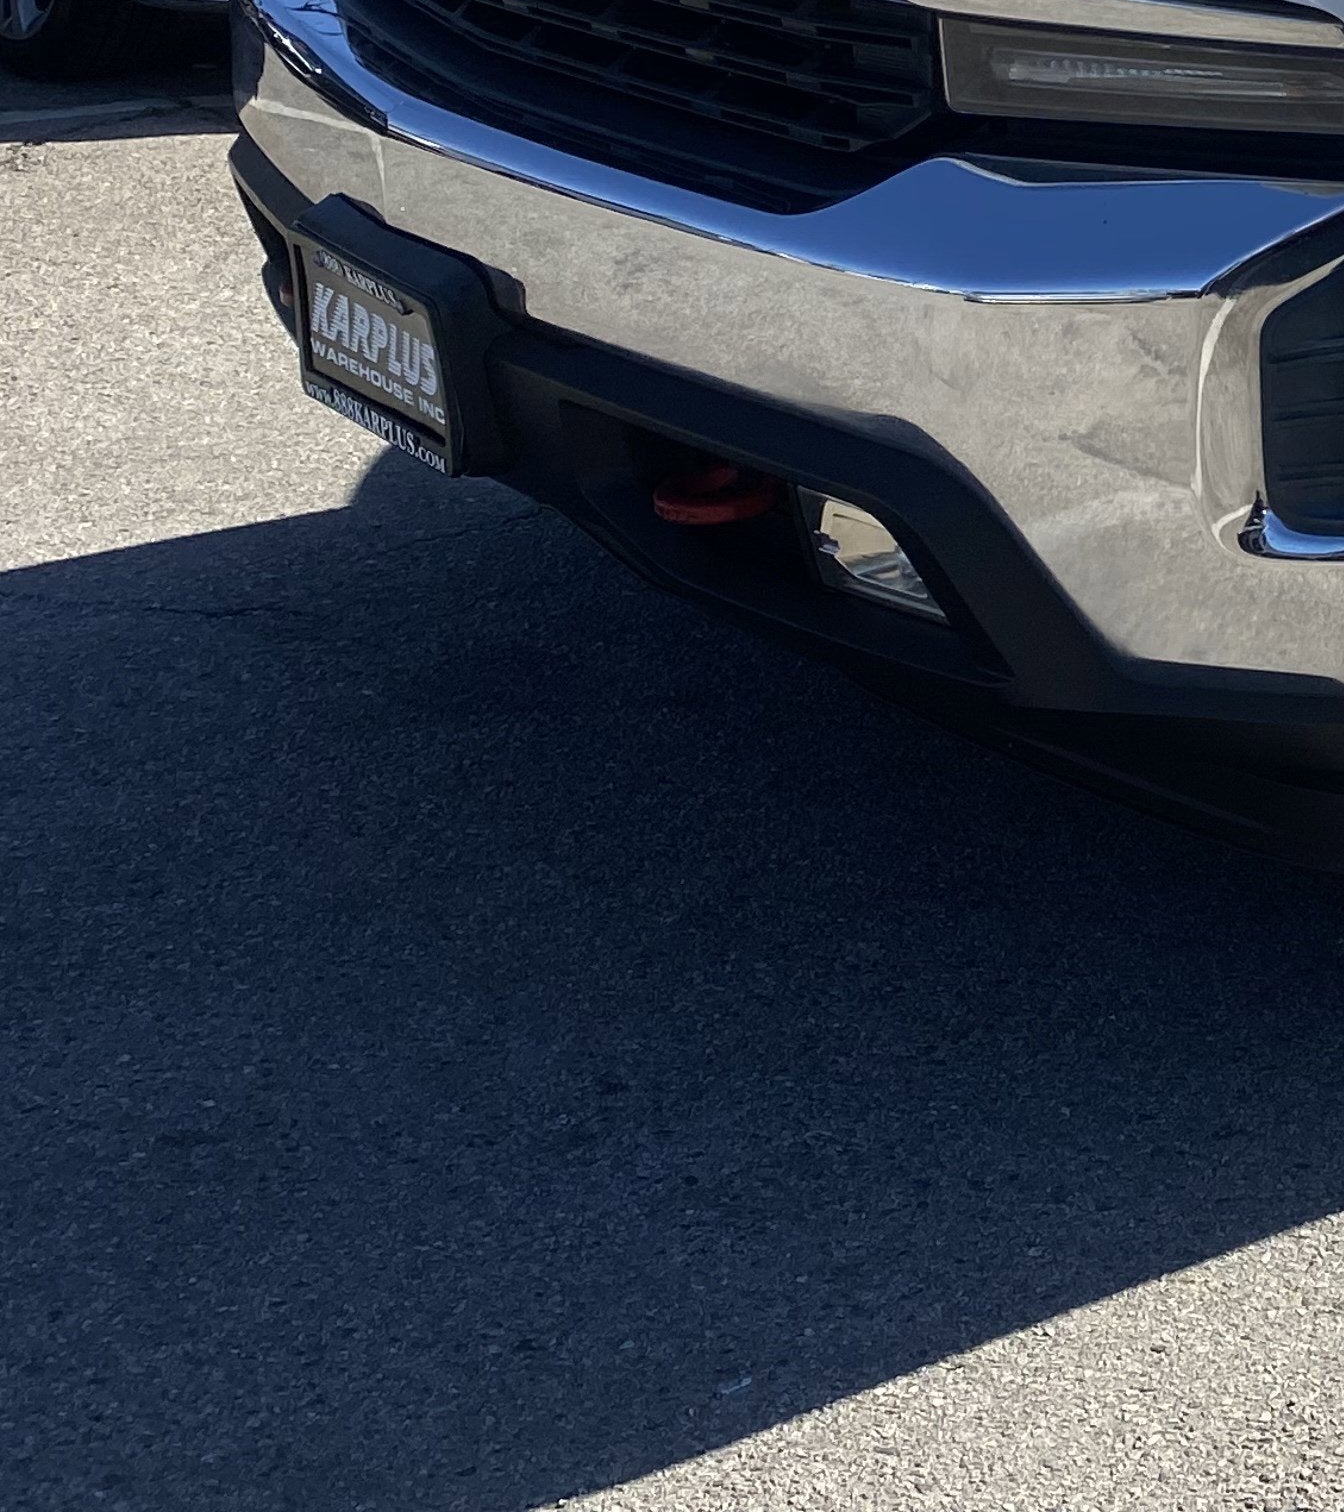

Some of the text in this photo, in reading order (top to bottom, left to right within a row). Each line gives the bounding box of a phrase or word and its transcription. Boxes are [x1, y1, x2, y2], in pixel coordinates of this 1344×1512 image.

[310, 337, 447, 425] WAREHOUSE INC
[311, 282, 438, 396] KARPLUS
